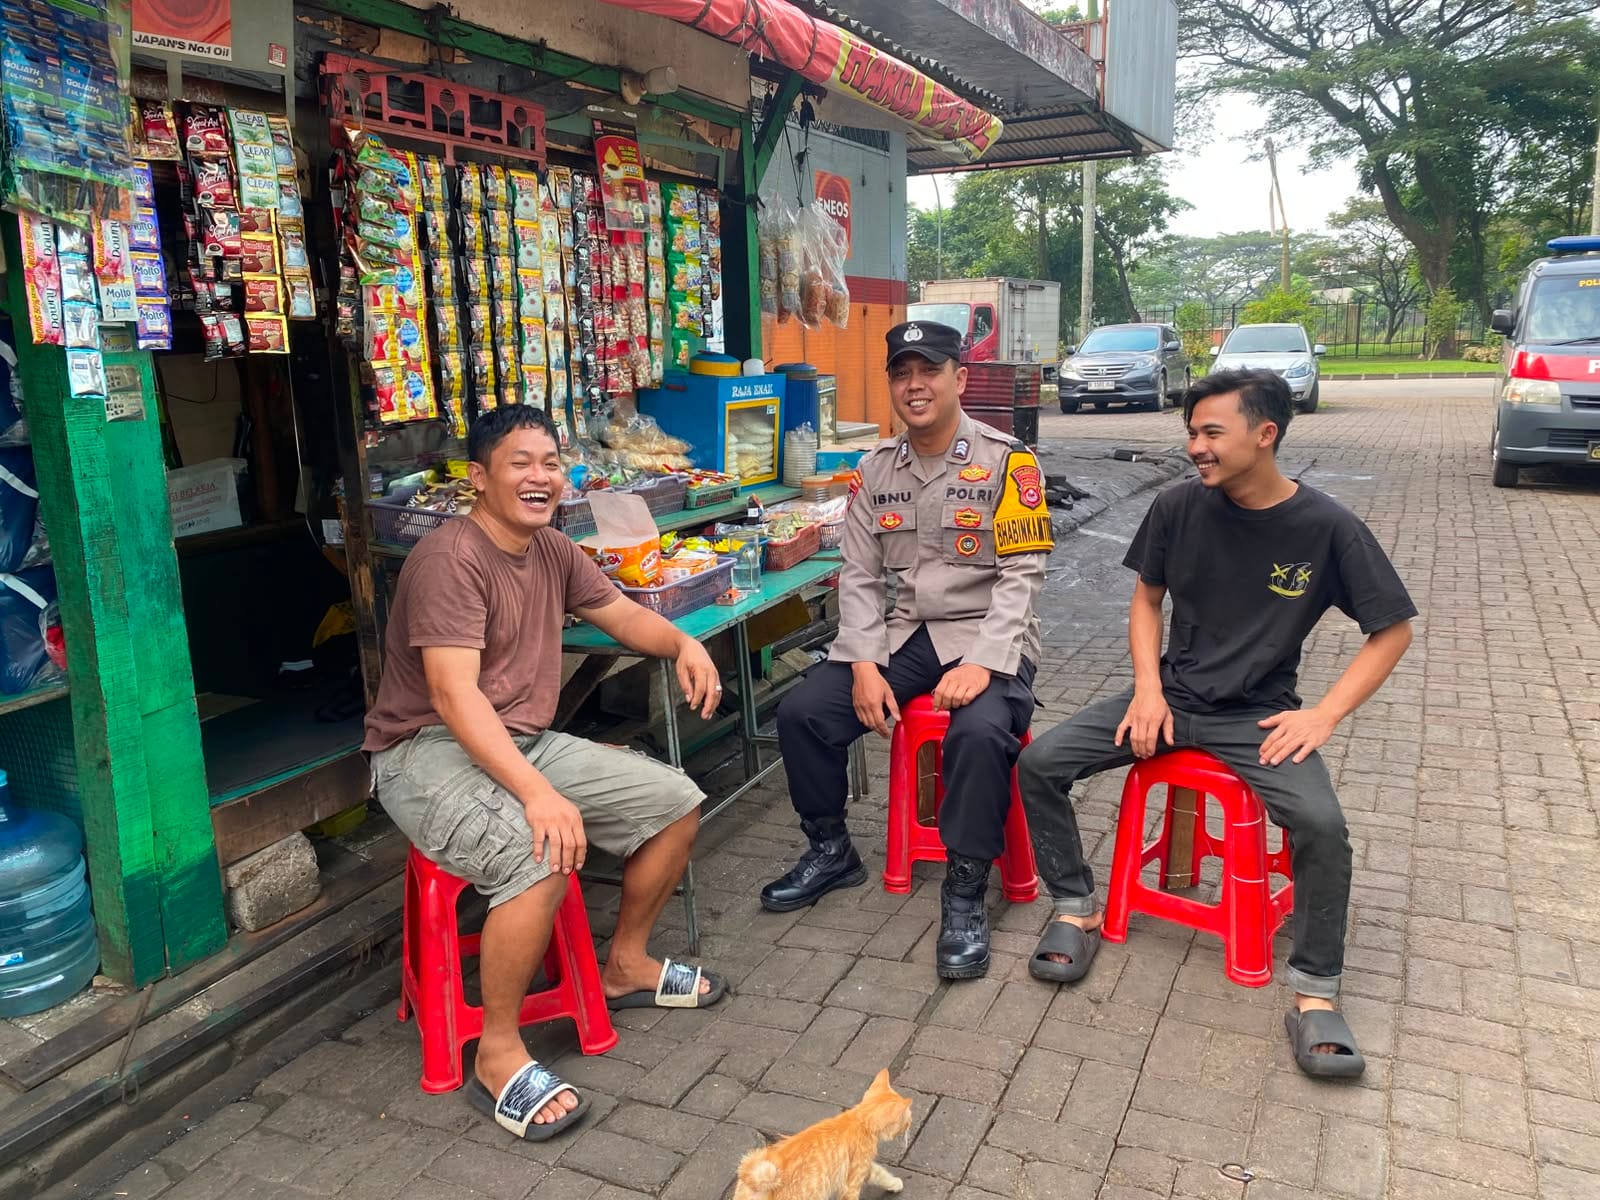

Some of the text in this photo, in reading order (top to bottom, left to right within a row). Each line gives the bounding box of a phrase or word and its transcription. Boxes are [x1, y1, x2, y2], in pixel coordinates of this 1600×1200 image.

[134, 34, 230, 57] JAPAN'S No.1 Oil
[3, 59, 41, 77] GOLIATH
[66, 78, 100, 94] GOLIATH
[235, 111, 264, 126] CLEAR
[241, 143, 272, 157] CLEAR
[246, 177, 275, 190] CLEAR
[41, 221, 52, 257] Down
[135, 265, 160, 277] Molto
[106, 287, 132, 299] Molto
[732, 383, 774, 398] RAJA ENAK
[872, 491, 912, 505] IBNU
[946, 487, 992, 501] POLRI
